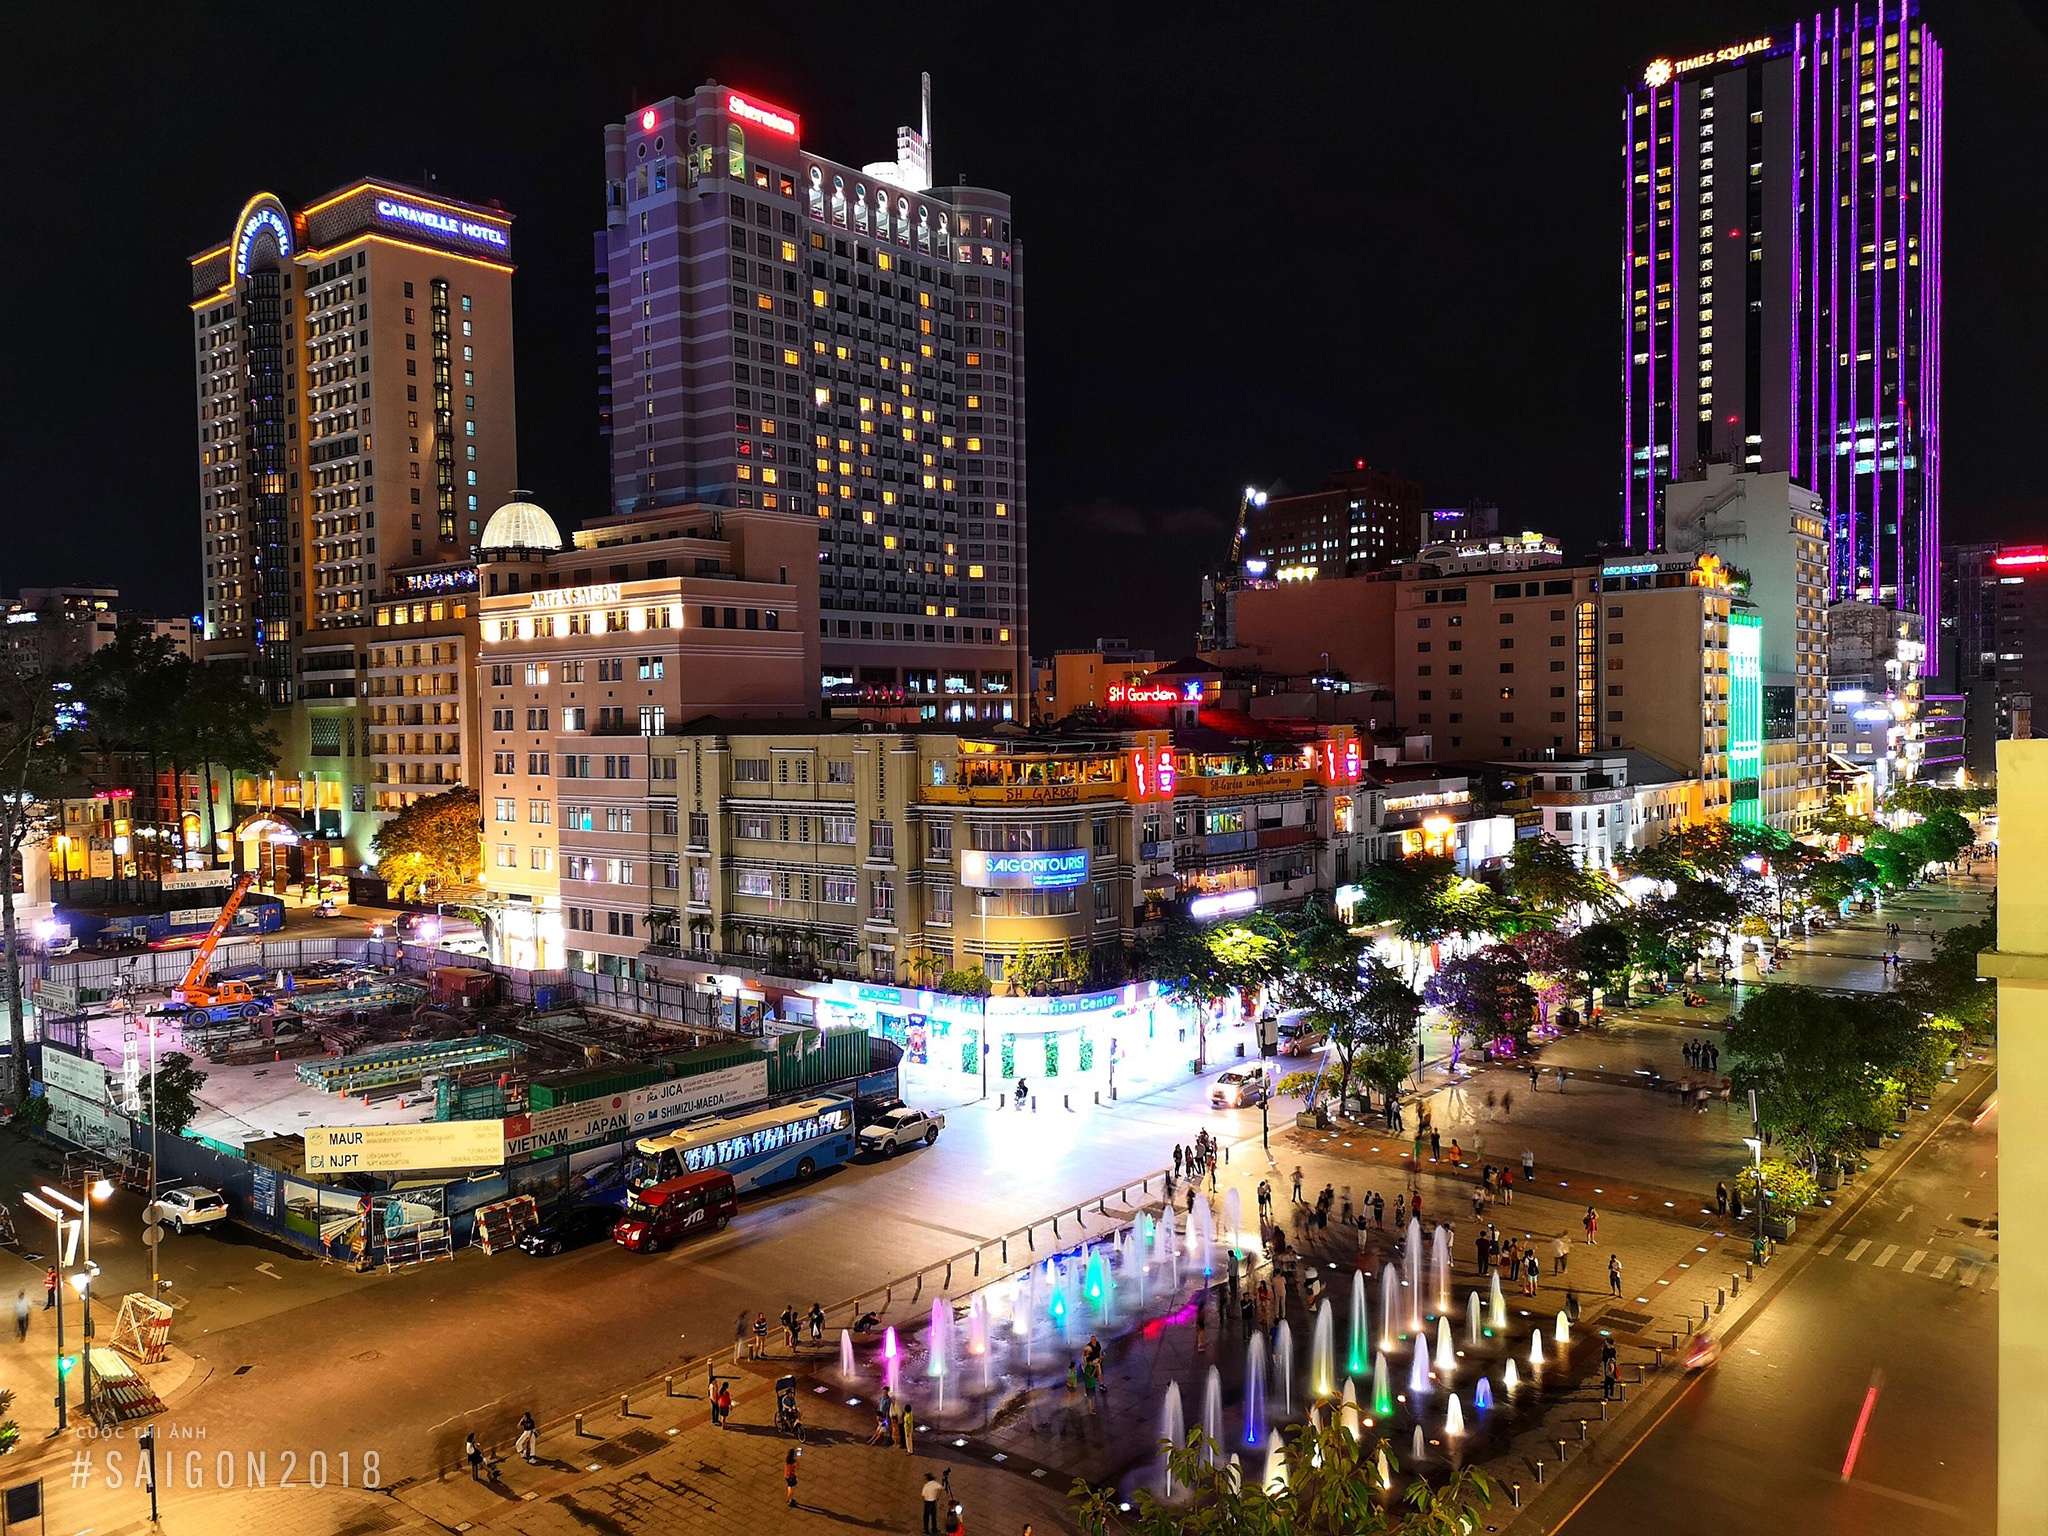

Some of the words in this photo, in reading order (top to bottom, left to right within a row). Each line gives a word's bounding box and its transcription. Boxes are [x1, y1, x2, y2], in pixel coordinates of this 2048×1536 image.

[1675, 53, 1715, 74] TIMES
[1715, 37, 1772, 63] SQUARE
[378, 200, 459, 234] CARAVELLE
[462, 221, 507, 245] HOTEL
[1603, 565, 1631, 576] OSCAR
[570, 585, 618, 605] SAIGON
[1109, 686, 1125, 702] SH
[1127, 684, 1177, 702] Garden
[1005, 787, 1023, 800] SH
[1032, 786, 1079, 799] GARDEN
[985, 856, 1085, 873] SAIGONTOURIST
[164, 881, 197, 890] VIETNAM
[205, 879, 229, 887] JAPAN
[939, 997, 984, 1015] Torist
[989, 1000, 1076, 1016] ormation
[1079, 993, 1118, 1012] Center
[660, 1084, 684, 1099] JICA
[661, 1093, 725, 1119] SHIMIZU-MAEDA
[329, 1132, 363, 1146] MAUR
[508, 1127, 568, 1154] VIETNAM
[584, 1113, 627, 1136] JAPAN
[330, 1154, 359, 1167] NJPT
[683, 1208, 705, 1227] JTB
